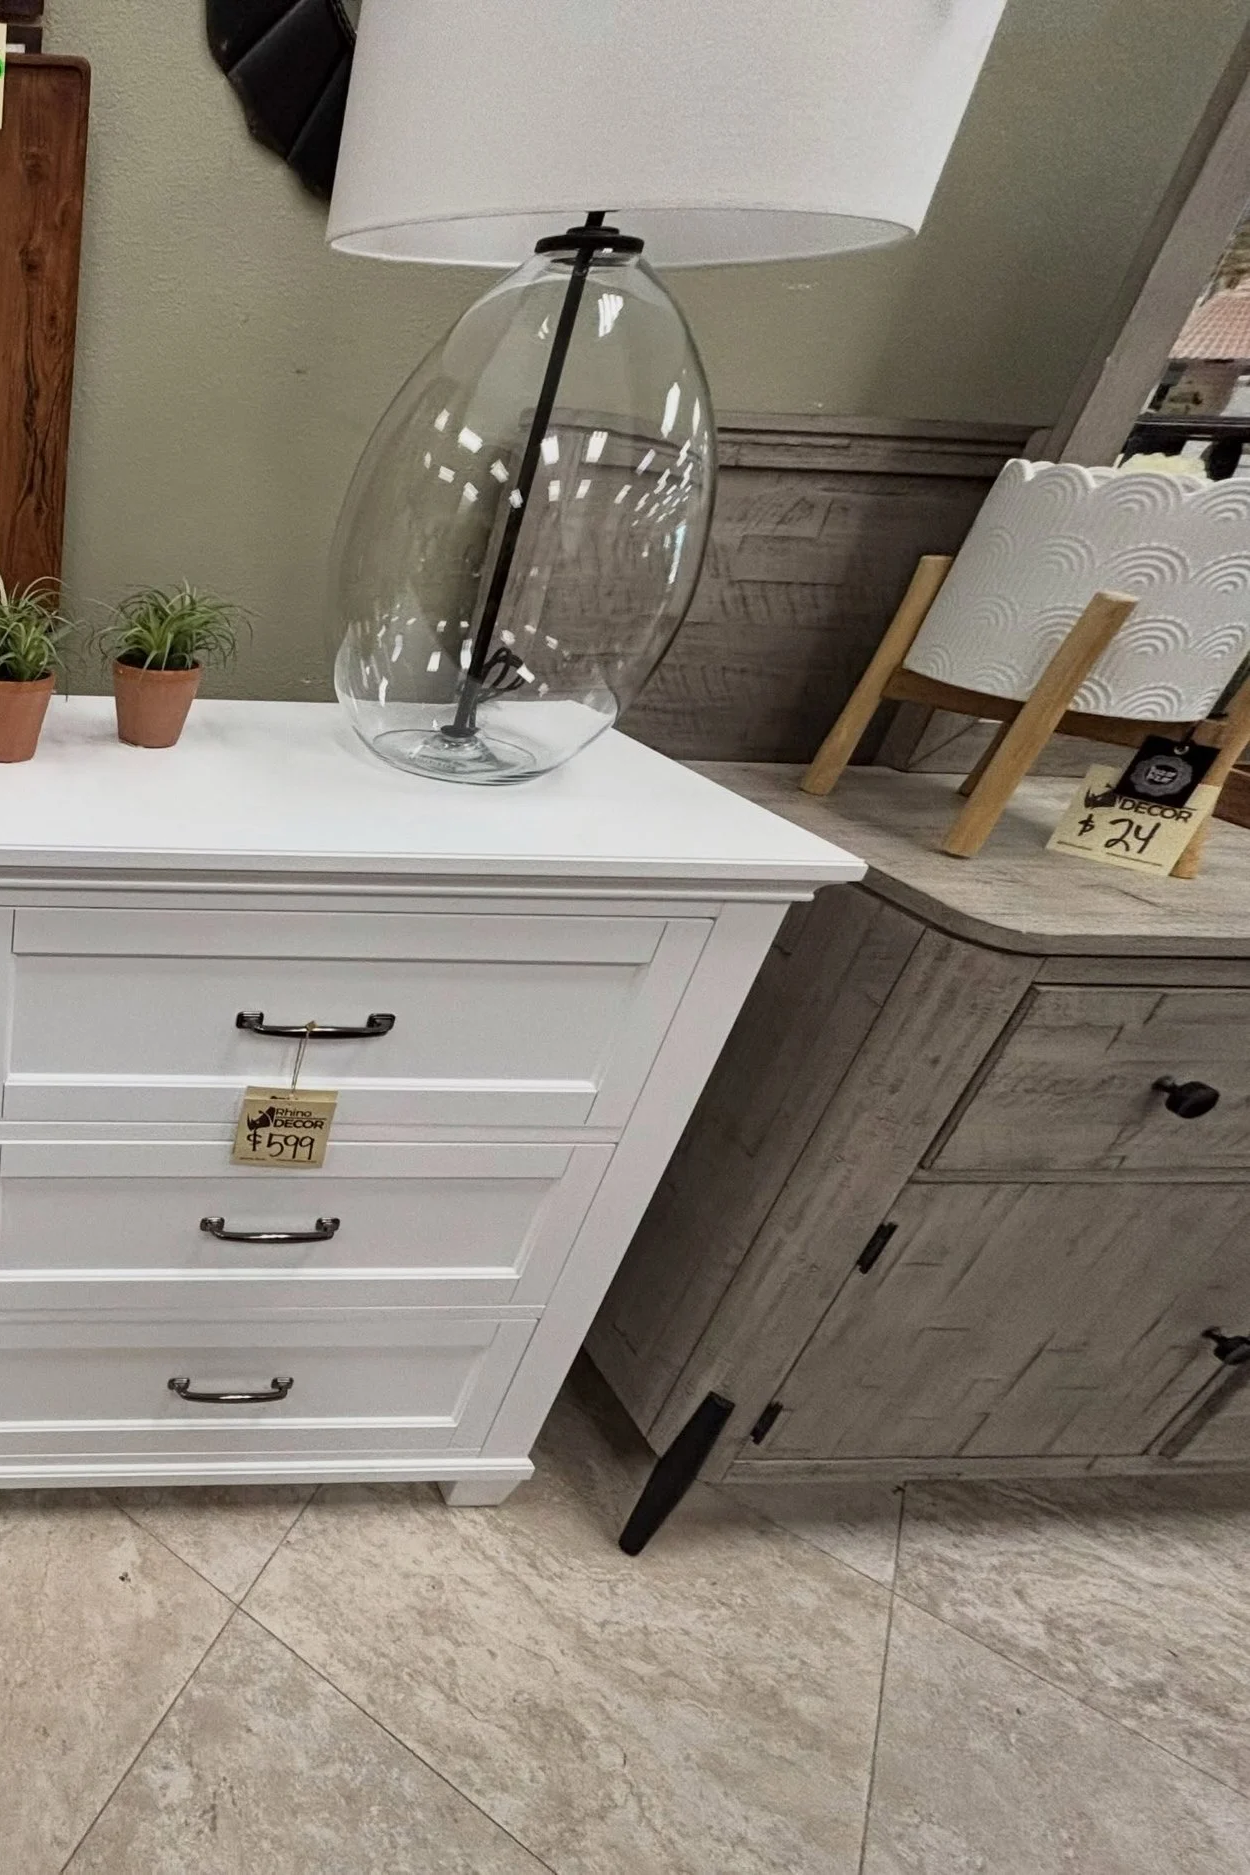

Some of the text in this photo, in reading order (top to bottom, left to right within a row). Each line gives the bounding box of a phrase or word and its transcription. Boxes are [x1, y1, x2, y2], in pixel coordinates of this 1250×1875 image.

[1119, 797, 1193, 824] DECOR
[276, 1108, 312, 1118] Rhino
[273, 1119, 325, 1130] DECOR
